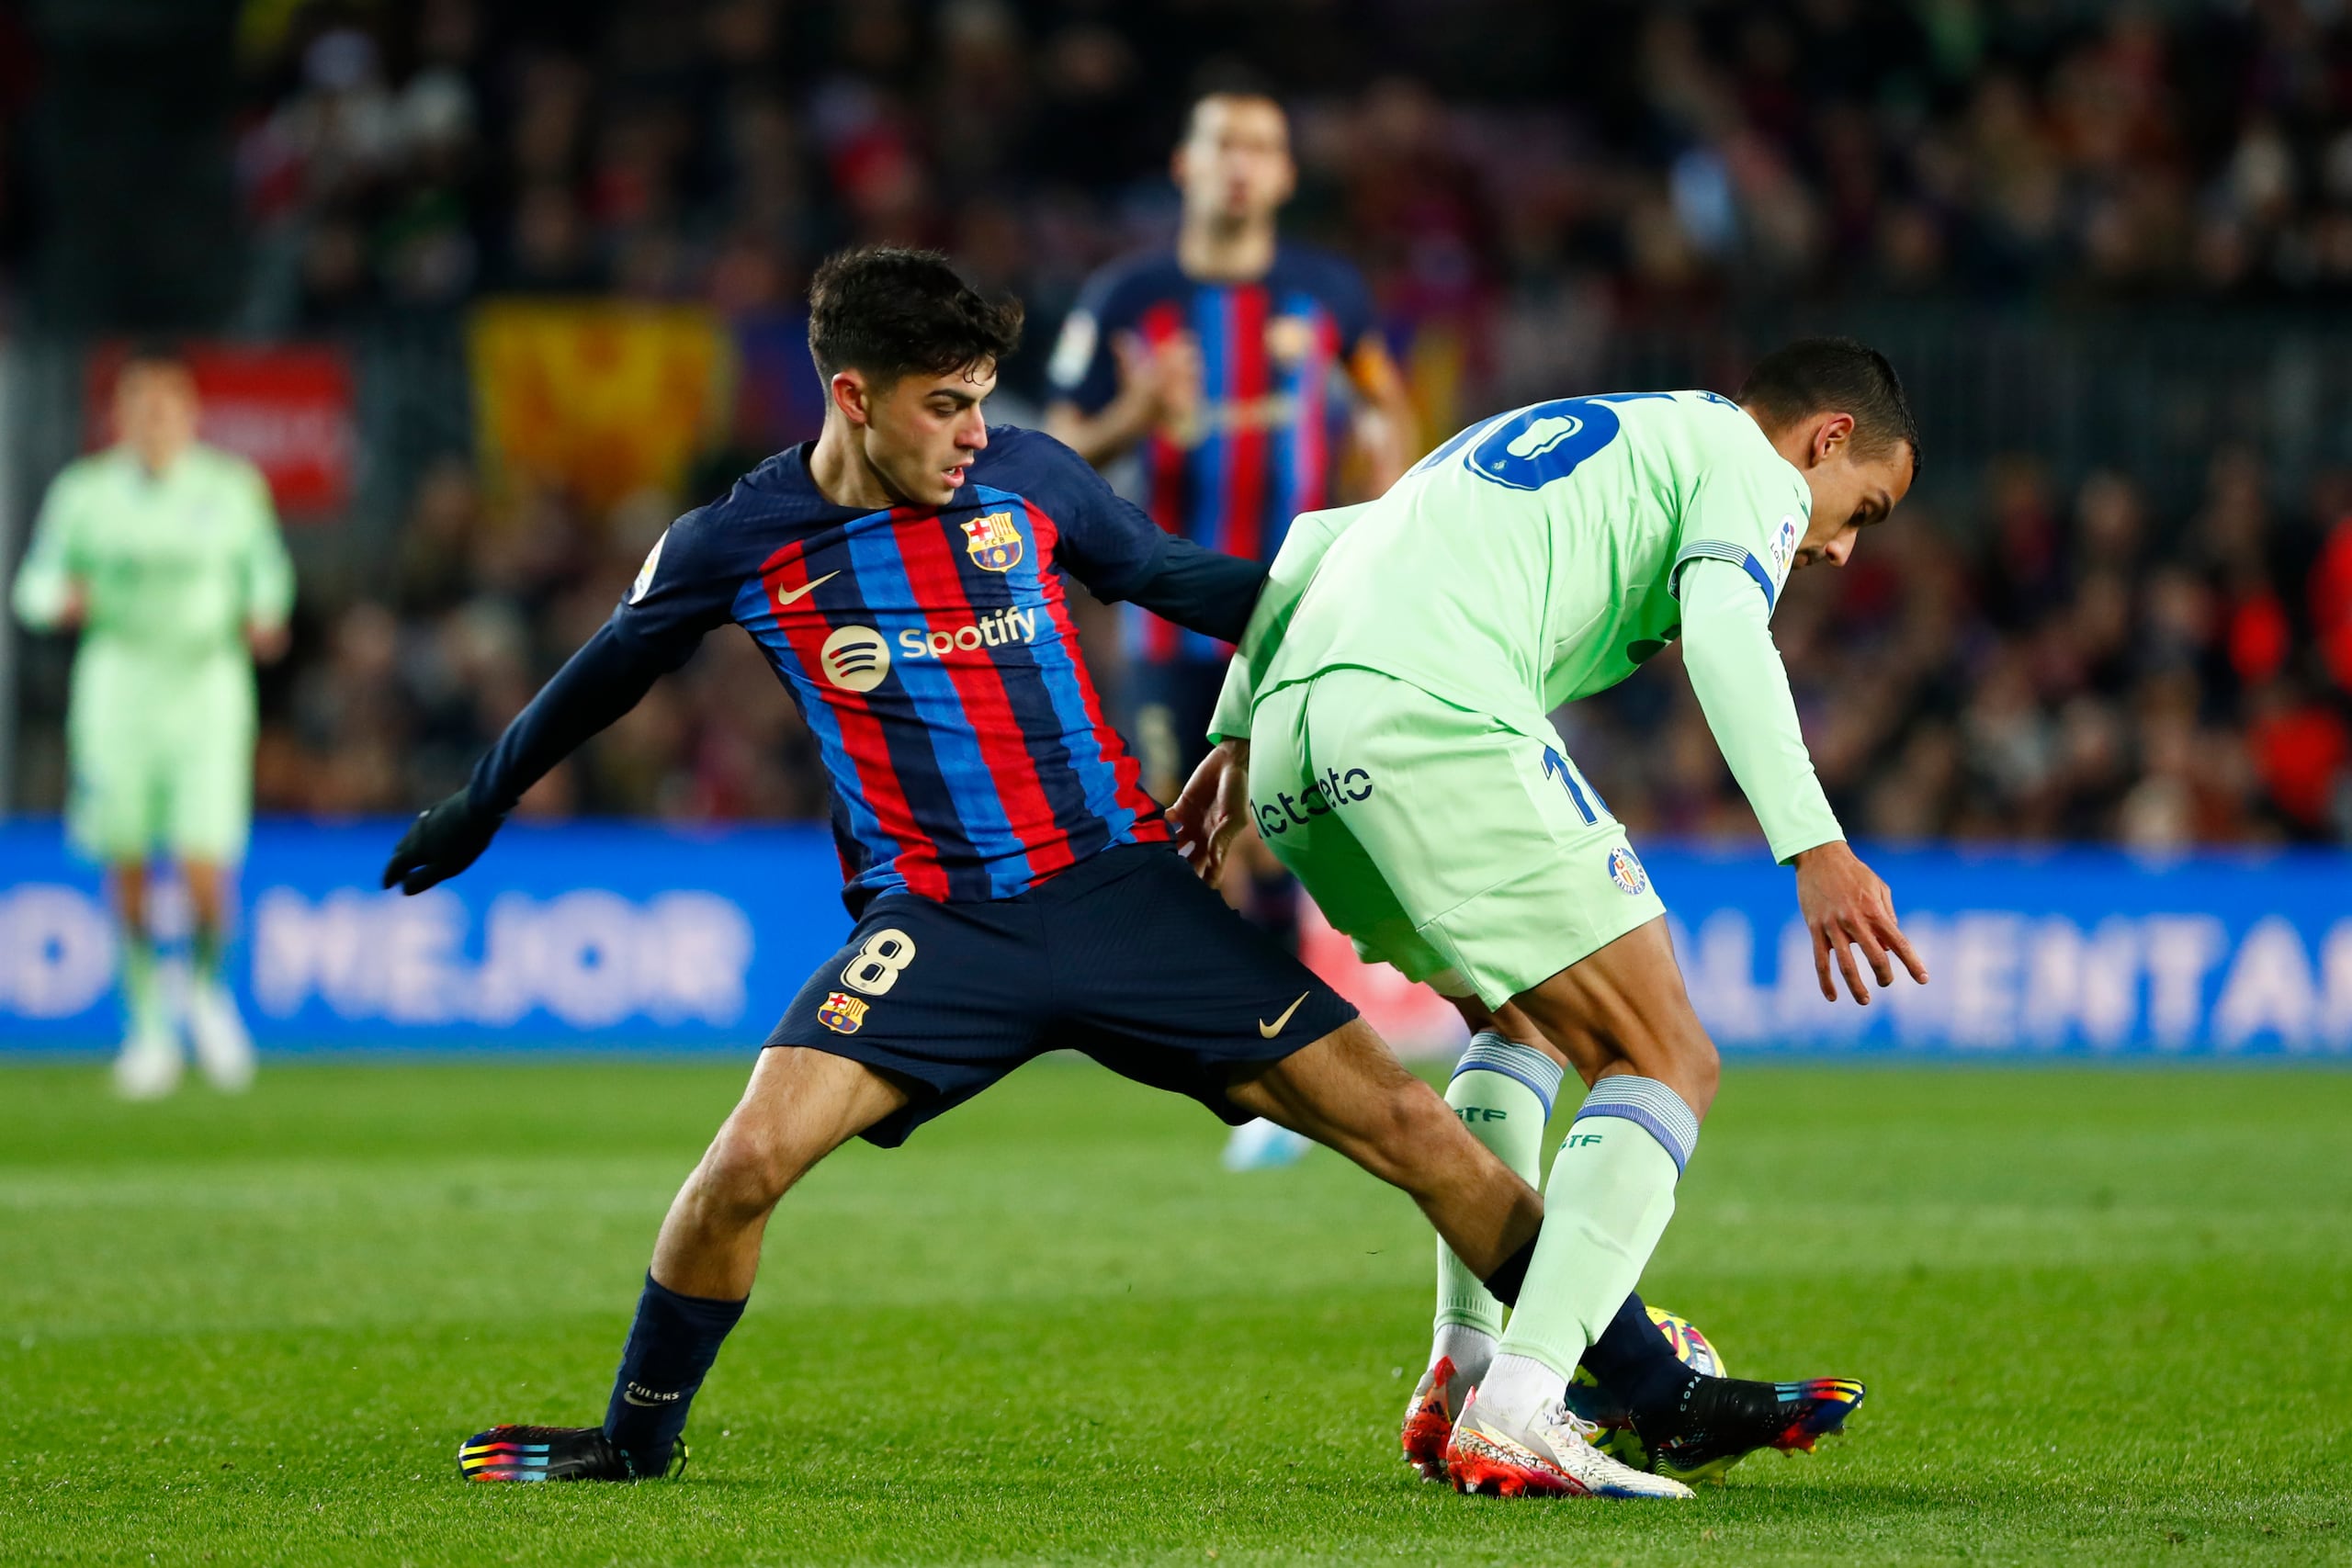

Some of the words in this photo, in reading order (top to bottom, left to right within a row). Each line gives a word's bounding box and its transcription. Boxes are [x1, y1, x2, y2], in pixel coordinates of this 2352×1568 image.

[899, 606, 1035, 659] Spotify
[252, 885, 754, 1027] MEJOR
[840, 928, 917, 996] 8
[628, 1381, 680, 1401] CULERS
